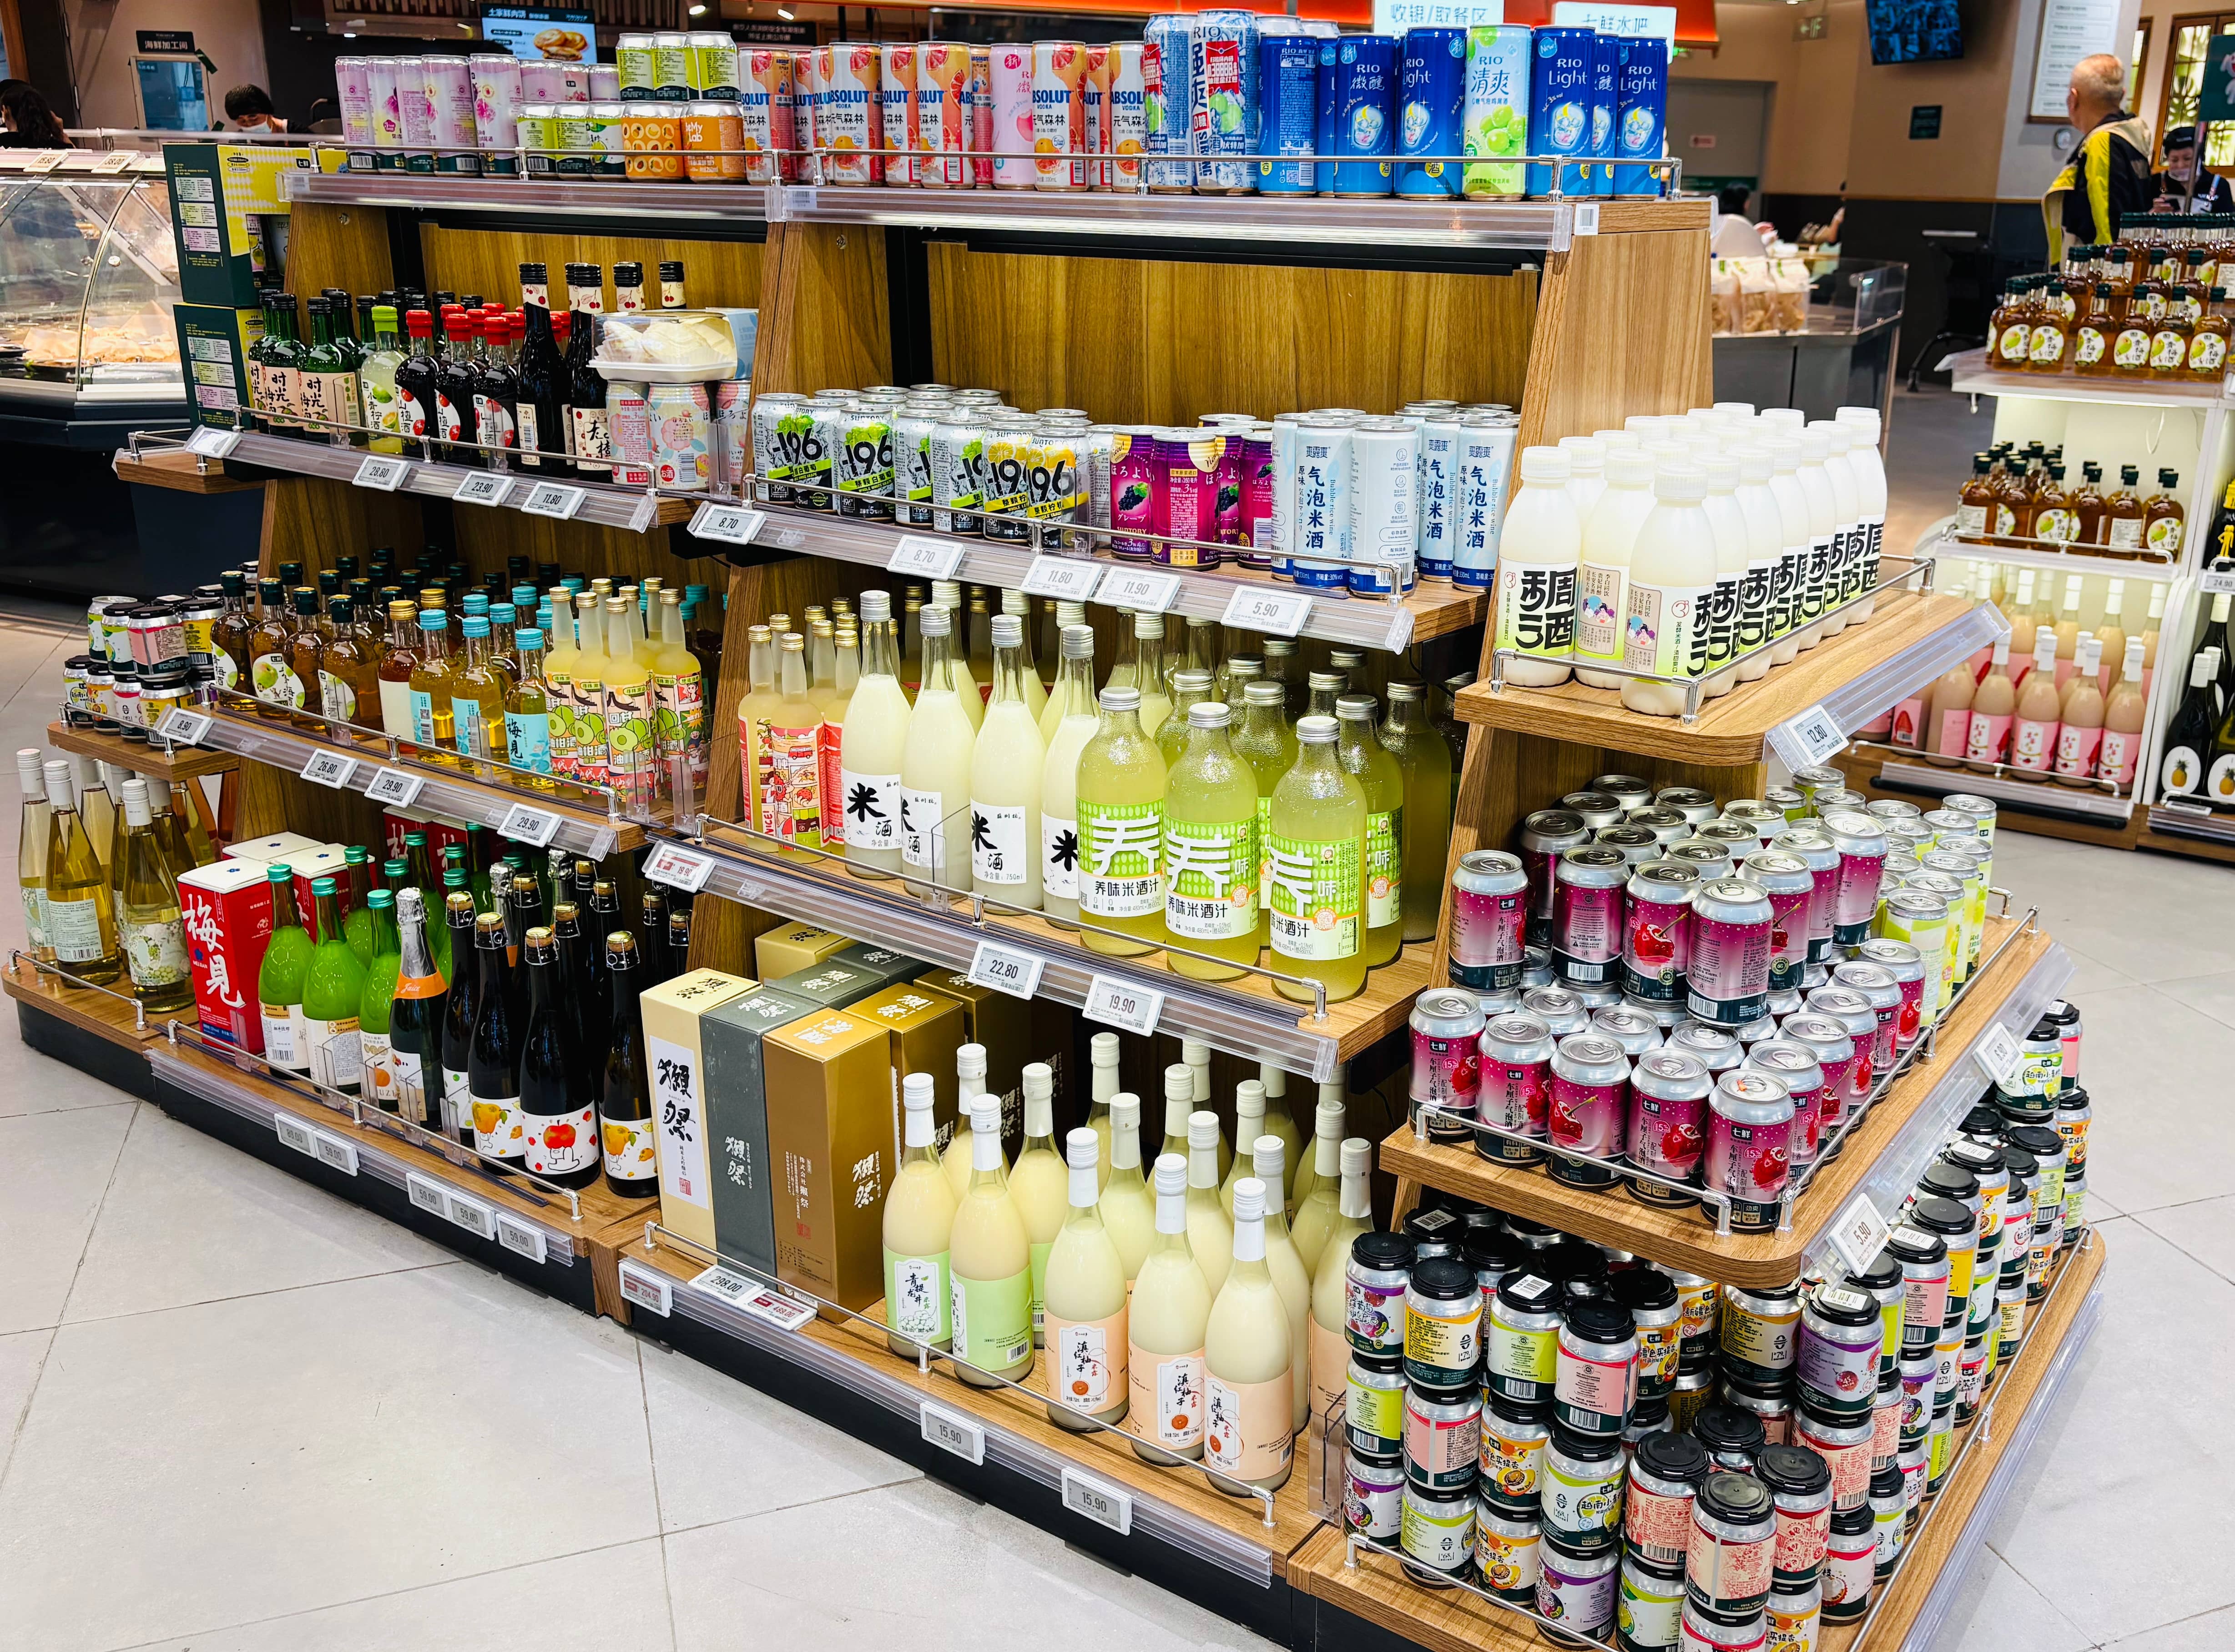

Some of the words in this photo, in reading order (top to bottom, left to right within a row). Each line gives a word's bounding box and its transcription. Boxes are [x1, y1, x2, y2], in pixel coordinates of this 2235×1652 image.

[1390, 4, 1488, 25] 收银/取餐区
[1194, 26, 1221, 39] RIO
[1406, 58, 1424, 68] RIO
[1479, 56, 1503, 65] RIO
[1557, 59, 1582, 68] RIO
[1357, 65, 1380, 73] RIO
[1597, 65, 1610, 73] IO
[1628, 66, 1653, 75] RIO
[1349, 75, 1385, 91] 微醺
[1471, 67, 1510, 96] 清爽
[1549, 70, 1588, 88] Light
[1620, 77, 1657, 94] Light
[830, 91, 870, 103] BSOLUT
[1033, 90, 1071, 103] BSOLUT
[1110, 91, 1144, 104] ABSOL
[689, 134, 703, 142] Lab
[1428, 163, 1440, 175] 酒
[271, 372, 290, 403] 时光
[307, 377, 325, 408] 时光
[368, 392, 383, 430] 小青柠酒
[399, 401, 414, 433] 山楂酒
[842, 433, 893, 477] -196
[369, 466, 390, 478] 28.80
[661, 468, 674, 479] お酒
[1298, 465, 1306, 485] 原味
[1422, 458, 1428, 478] 原味
[1459, 466, 1468, 485] 原味
[987, 458, 1022, 499] -19
[471, 481, 494, 493] 23.90
[542, 493, 562, 505] 11.80
[1426, 459, 1445, 539] 气泡米酒
[1306, 466, 1326, 549] 气泡米酒
[1466, 466, 1487, 549] 气泡米酒
[719, 517, 739, 528] 8.70
[1118, 514, 1146, 523] グレープ
[913, 549, 935, 563] 8.70
[1047, 569, 1073, 584] 11.80
[1123, 581, 1150, 595] 11.90
[1252, 601, 1279, 617] 5.90
[177, 720, 192, 731] 8.90
[609, 711, 633, 725] 回甘
[1807, 724, 1827, 744] 12.80
[317, 761, 338, 774] 26.80
[383, 779, 403, 793] 29.90
[847, 782, 893, 837] 米酒
[516, 816, 540, 831] 29.90
[1092, 811, 1160, 876] 养
[1165, 828, 1231, 899] 养
[1235, 857, 1249, 877] 味
[1375, 850, 1391, 870] 味
[677, 865, 692, 877] 19.90
[1095, 878, 1159, 897] 养味米酒汁
[1317, 880, 1337, 903] 味
[1168, 895, 1228, 919] 养味米酒汁
[1500, 899, 1515, 908] 七鲜
[1496, 917, 1506, 962] 车厘子气泡酒
[989, 960, 1019, 979] 22.80
[401, 983, 420, 993] Juice
[1109, 994, 1135, 1014] 19.90
[1878, 1011, 1892, 1020] 七鲜
[1431, 1042, 1447, 1051] 七鲜
[1429, 1058, 1438, 1102] 车厘子气泡酒
[1504, 1082, 1514, 1129] 车厘子气泡酒
[1644, 1099, 1660, 1113] 七鲜
[1638, 1116, 1648, 1164] 车厘子气泡酒
[1732, 1128, 1751, 1139] 七鲜
[325, 1146, 342, 1161] 59.00
[1725, 1145, 1738, 1195] 车厘子气泡酒
[419, 1189, 437, 1205] 59.00
[460, 1207, 478, 1224] 59.00
[509, 1230, 529, 1247] 59.00
[1853, 1221, 1871, 1245] 5.90
[710, 1275, 743, 1293] 298.00
[641, 1288, 659, 1303] 204.90
[773, 1305, 795, 1318] 489.00
[939, 1425, 961, 1444] 15.90
[1082, 1491, 1107, 1513] 15.90
